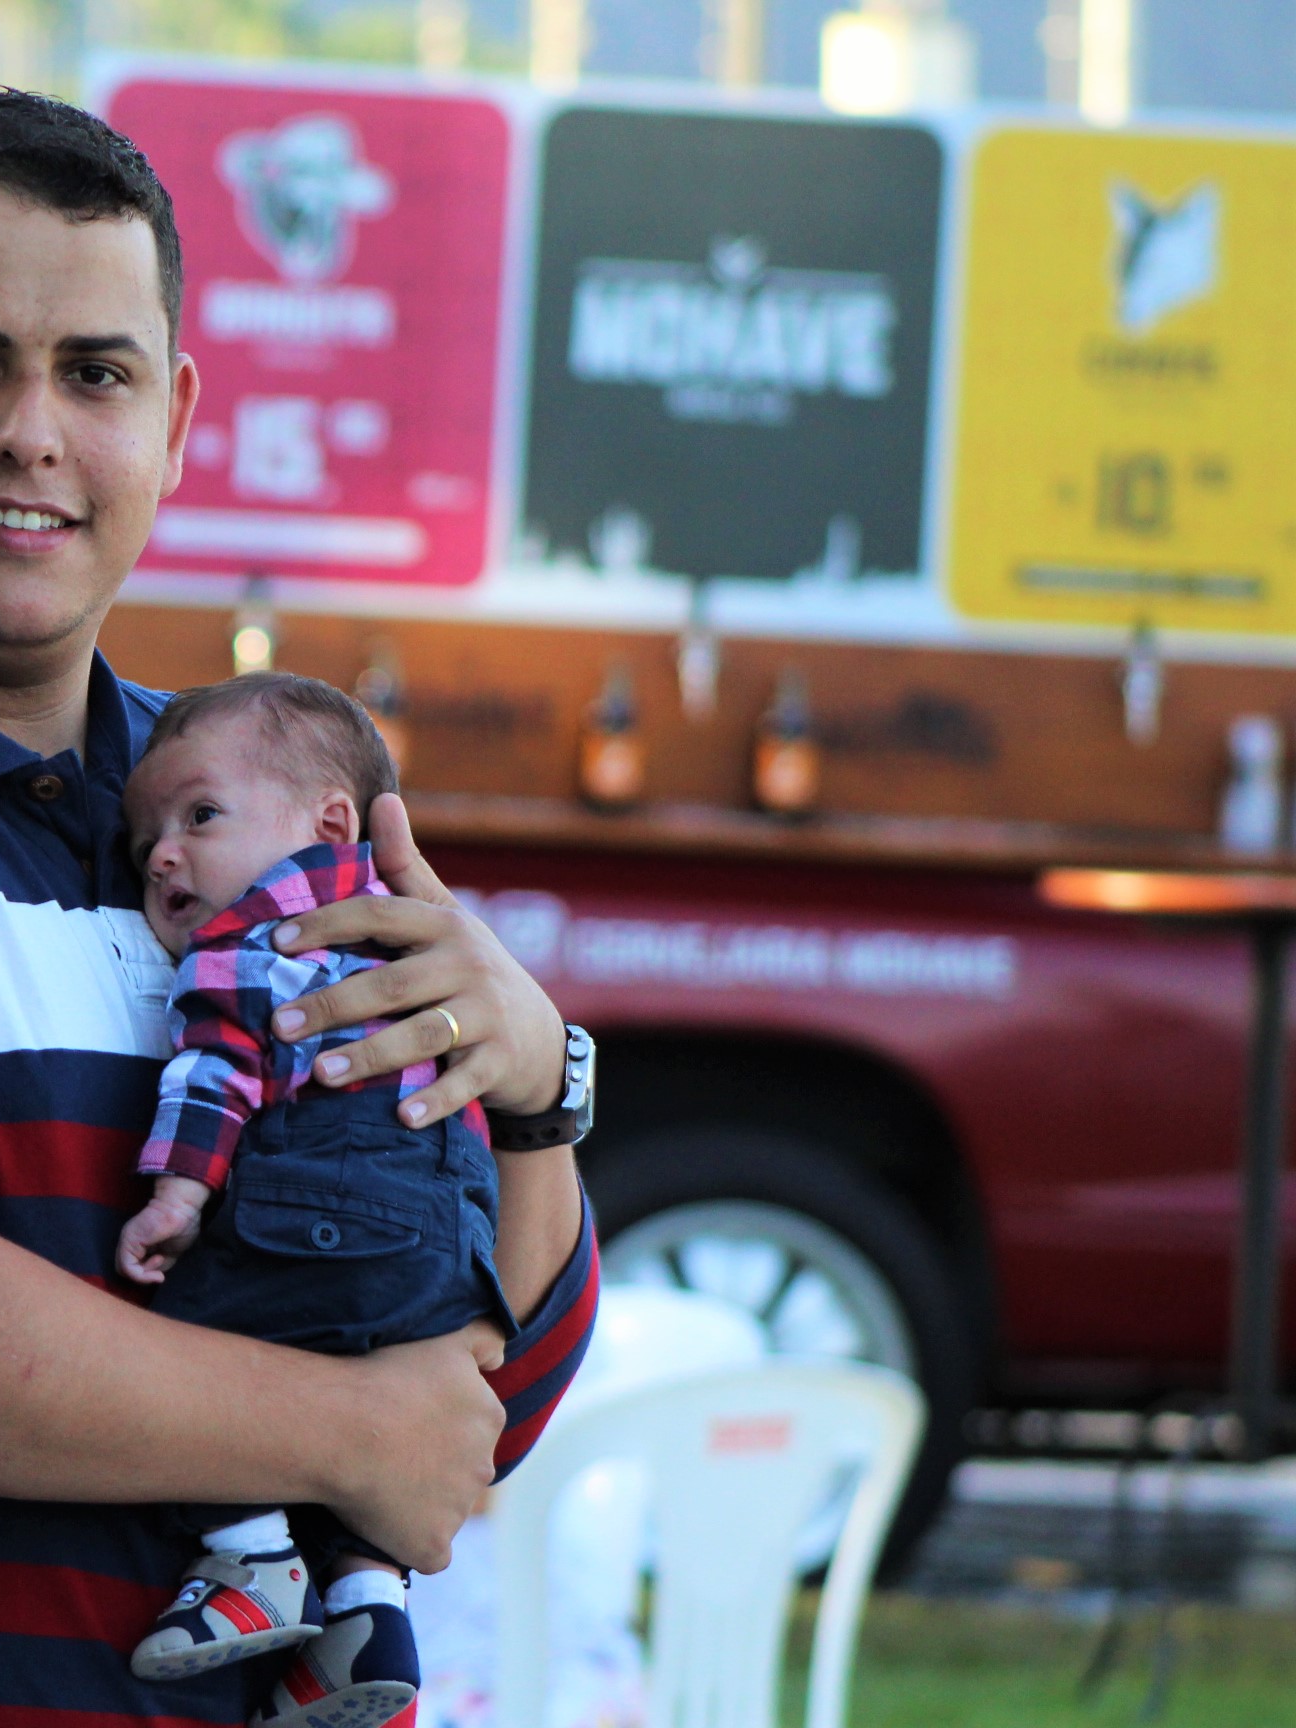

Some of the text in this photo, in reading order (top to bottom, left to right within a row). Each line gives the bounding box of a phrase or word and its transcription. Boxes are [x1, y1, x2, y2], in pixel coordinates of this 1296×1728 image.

[570, 278, 898, 398] MOHAVE
[231, 396, 326, 500] 15
[1095, 450, 1174, 540] 10
